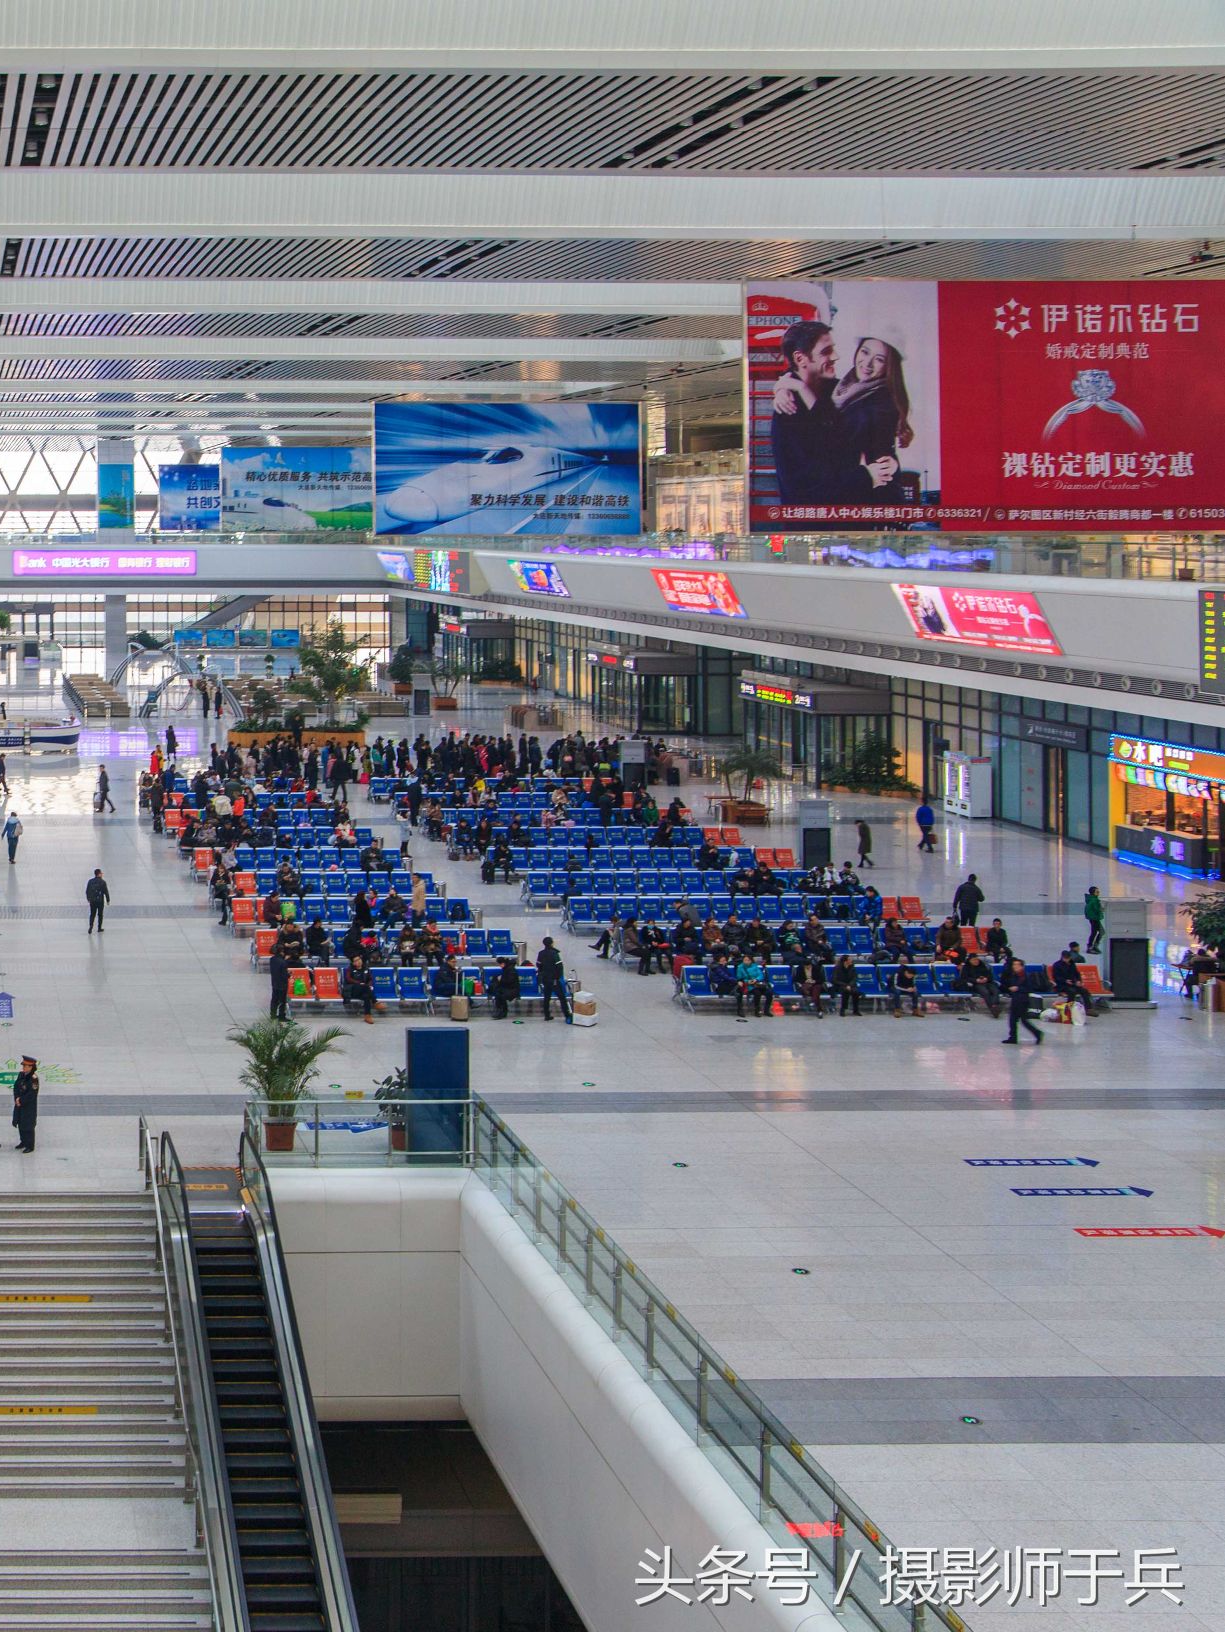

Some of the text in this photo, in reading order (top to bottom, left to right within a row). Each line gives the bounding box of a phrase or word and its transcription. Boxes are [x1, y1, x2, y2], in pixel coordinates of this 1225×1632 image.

[1040, 303, 1200, 333] 伊诺尔钻石
[1044, 342, 1150, 360] 婚戒定制典范
[1001, 451, 1195, 478] 裸钻定制更实惠
[470, 494, 629, 506] 聚力科学发展 建设和谐高铁
[937, 508, 982, 518] 6336321
